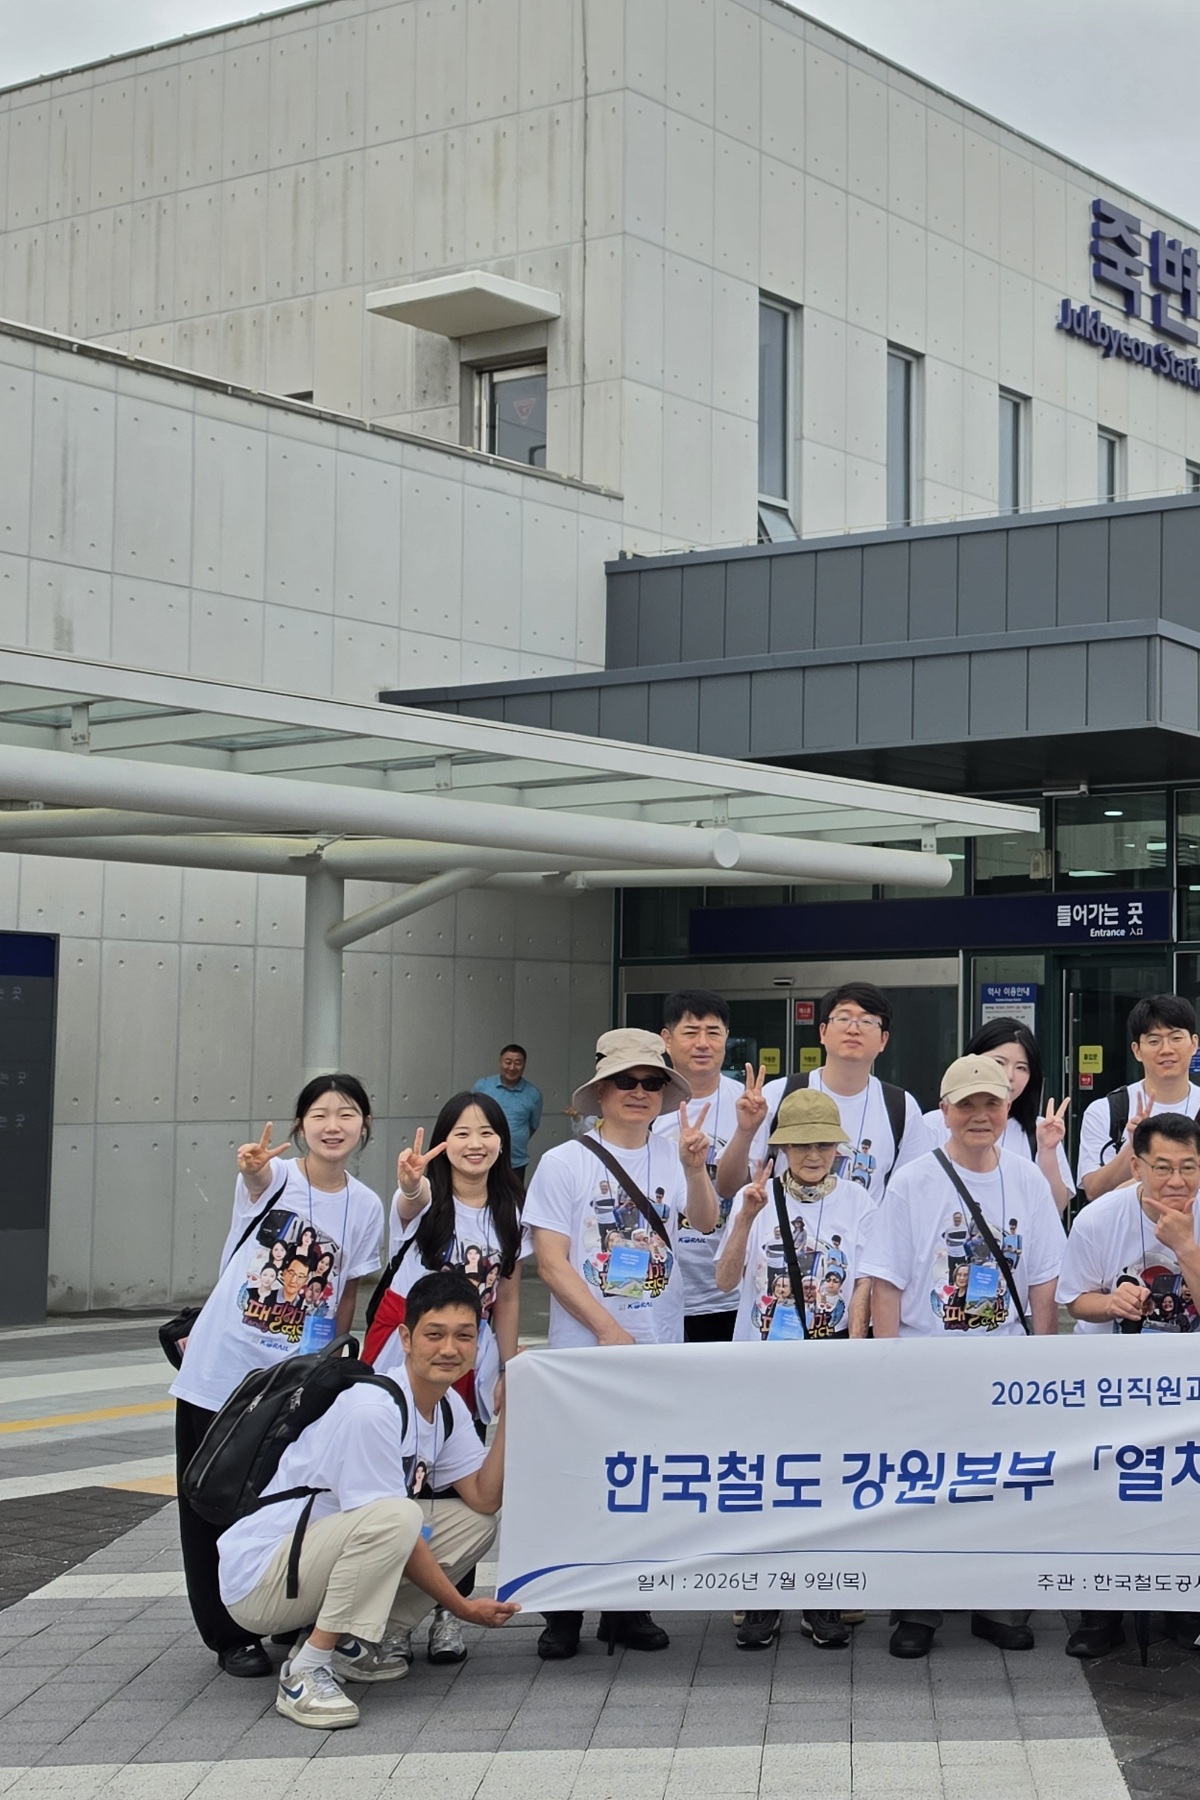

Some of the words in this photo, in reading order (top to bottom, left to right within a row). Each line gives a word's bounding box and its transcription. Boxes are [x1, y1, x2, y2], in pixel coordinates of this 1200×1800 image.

[1056, 298, 1157, 368] Jukbyeon
[1057, 903, 1119, 926] 들어가는
[1127, 902, 1143, 925] 곳
[1090, 928, 1126, 937] Entrance
[1129, 927, 1143, 936] 入口
[987, 987, 1001, 997] 역사
[1003, 986, 1030, 997] 이용안내
[260, 1340, 289, 1352] KORAIL
[992, 1380, 1085, 1407] 2026년
[605, 1451, 822, 1513] 한국철도
[842, 1450, 1055, 1509] 강원본부
[637, 1573, 675, 1592] 일시
[693, 1572, 759, 1591] 2026년
[767, 1571, 796, 1591] 7월
[804, 1571, 867, 1591] 9일(목)
[1037, 1574, 1076, 1592] 주관
